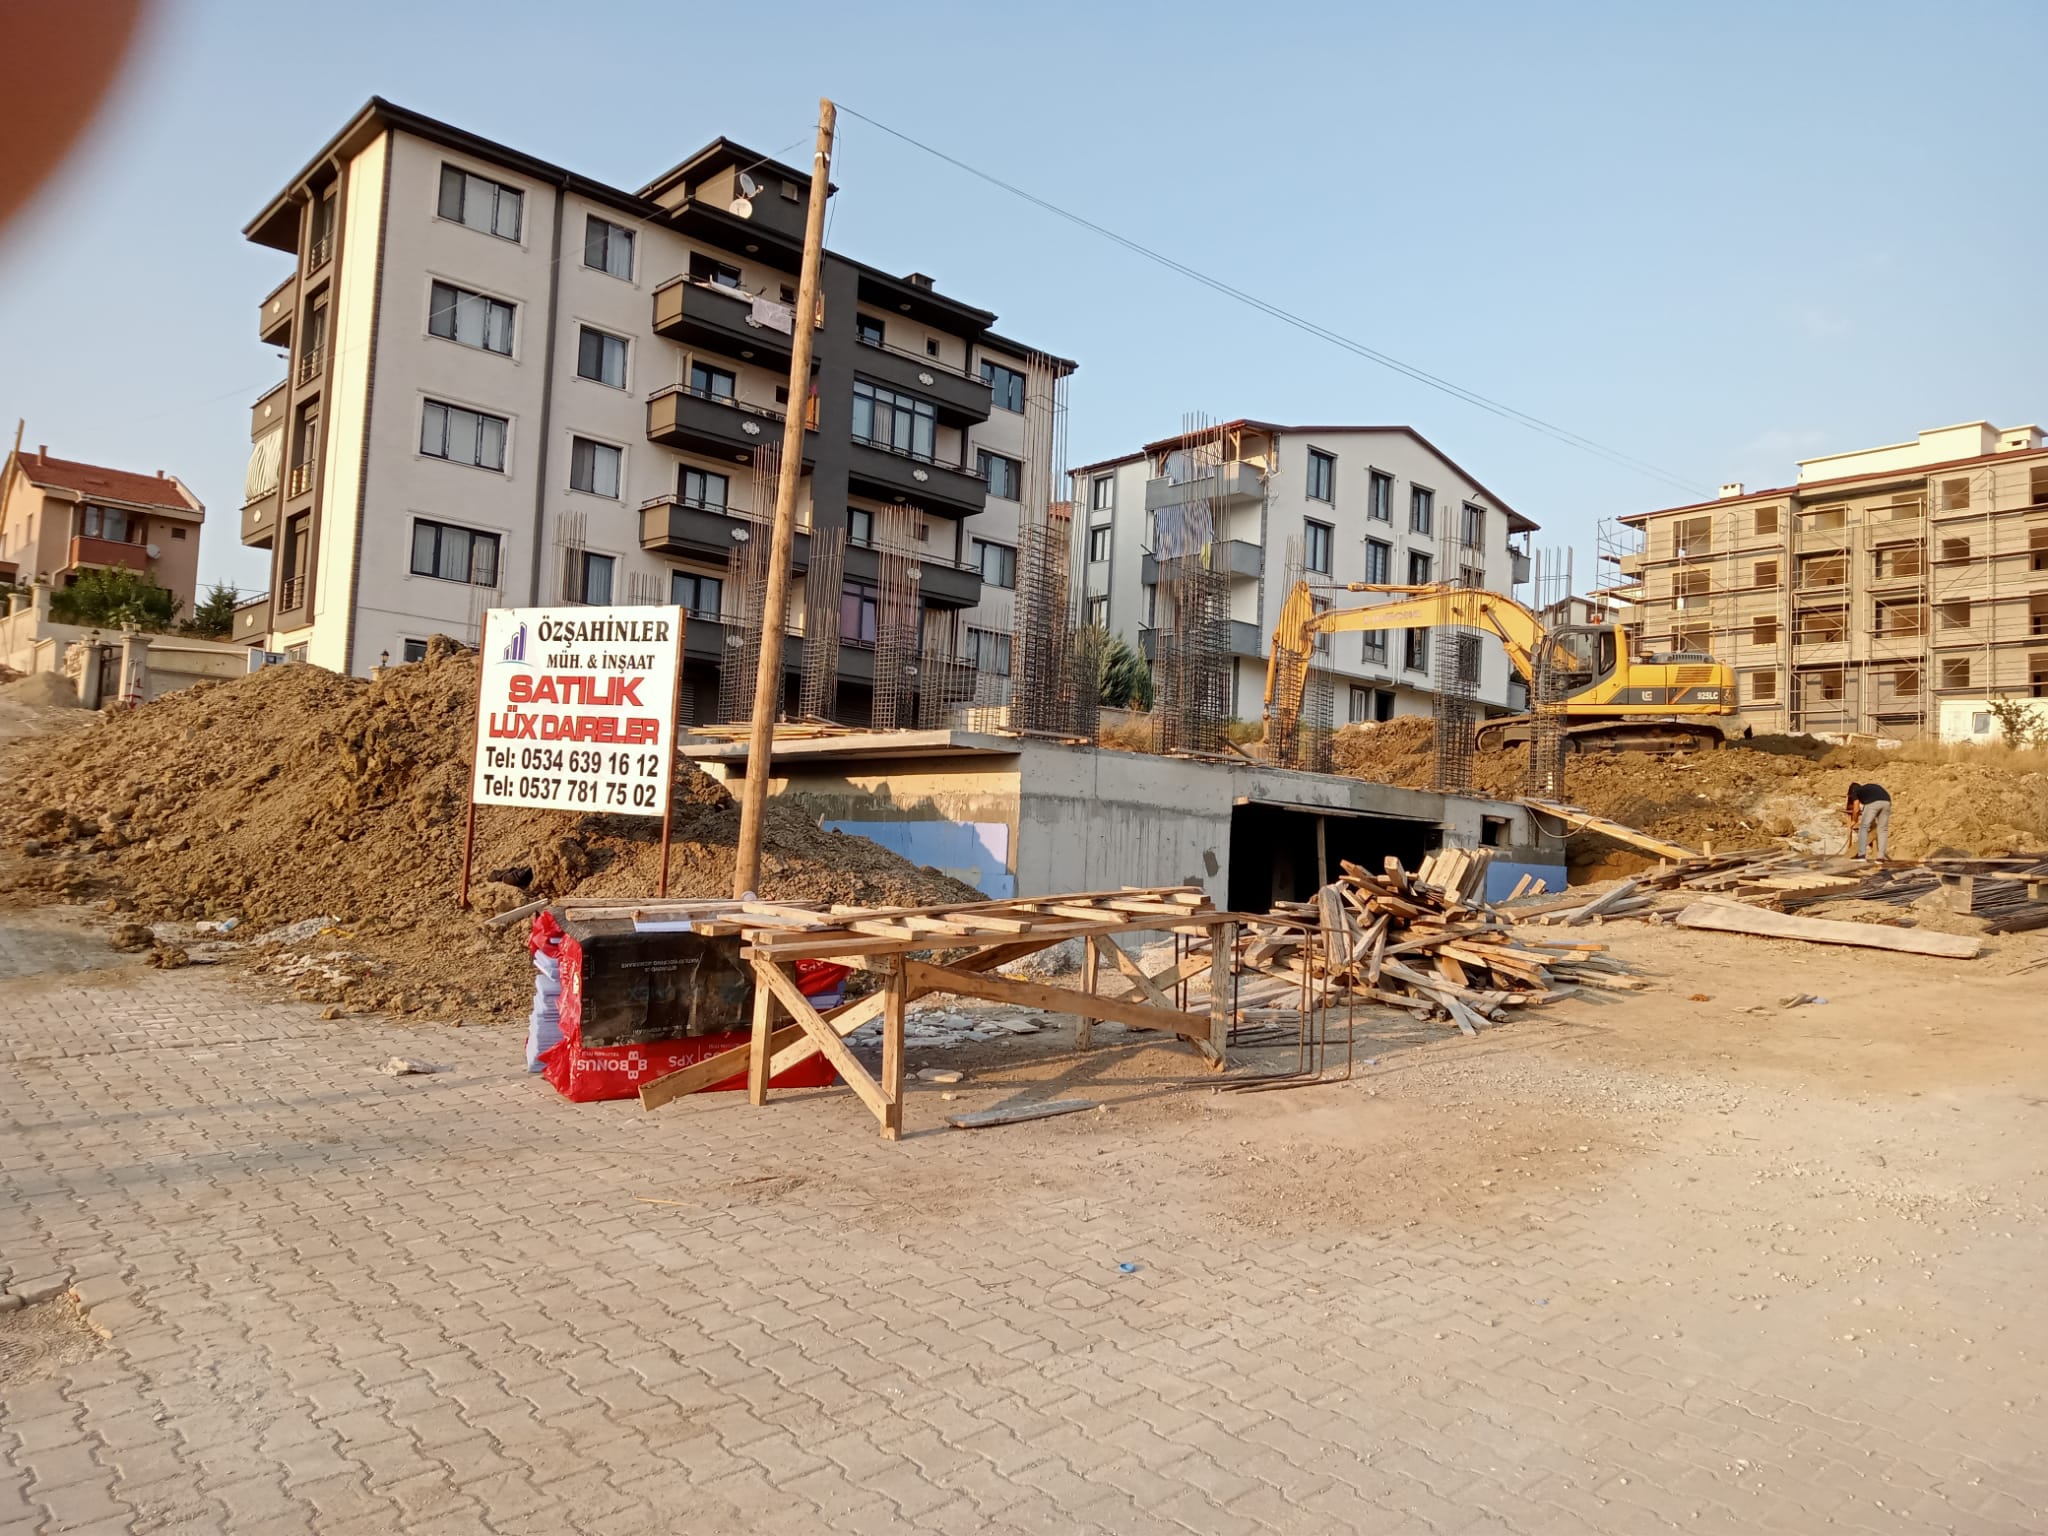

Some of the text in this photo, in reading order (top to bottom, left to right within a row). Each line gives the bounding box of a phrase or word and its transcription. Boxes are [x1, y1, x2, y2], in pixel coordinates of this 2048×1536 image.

[538, 614, 669, 648] ÖZŞAHİNLER
[546, 650, 655, 673] MÜH. & İNŞAAT
[508, 675, 645, 706] SATILIK
[489, 705, 539, 740] LÜX
[486, 746, 659, 777] Tel: 0534 639 16 12
[483, 774, 657, 807] Tel: 0537 781 75 02
[576, 1058, 629, 1072] BONUS
[668, 1053, 694, 1068] XPS
